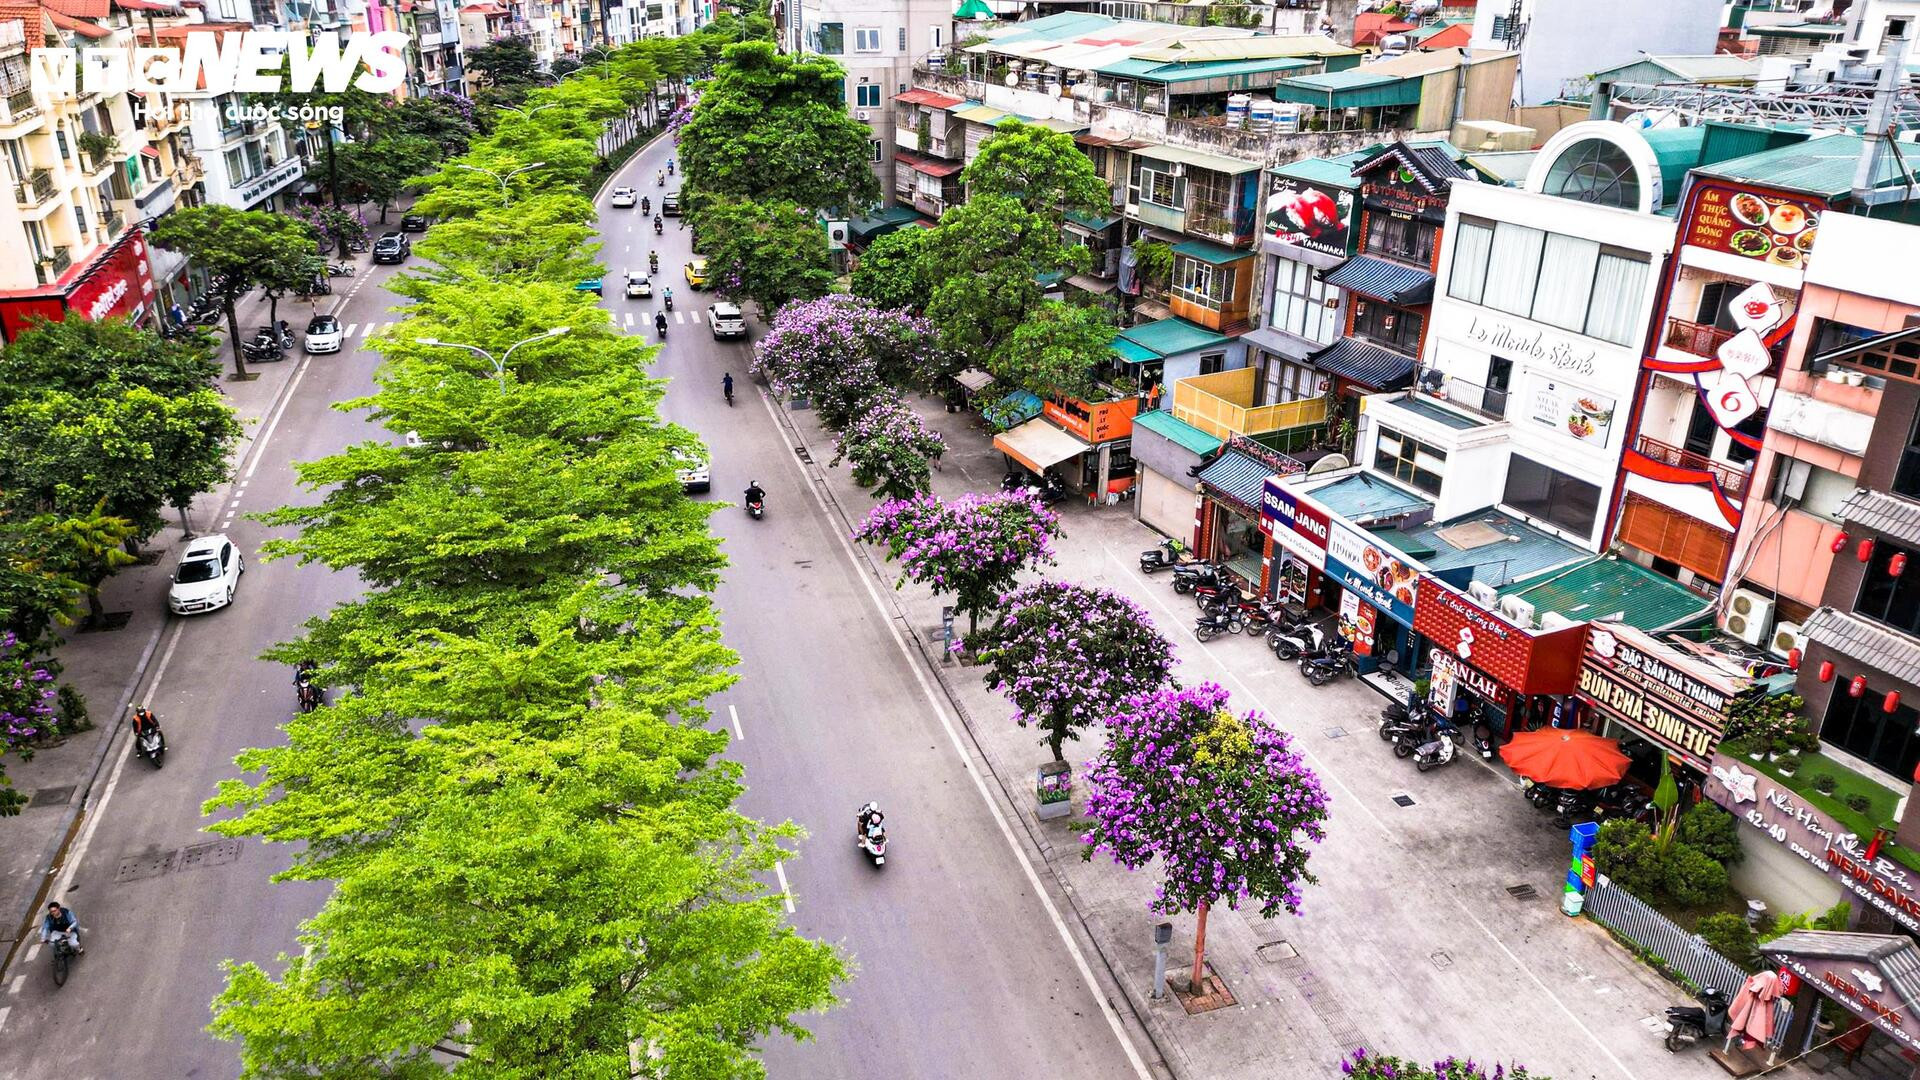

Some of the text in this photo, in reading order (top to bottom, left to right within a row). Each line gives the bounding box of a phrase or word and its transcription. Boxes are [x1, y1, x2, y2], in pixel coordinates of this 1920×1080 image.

[1302, 239, 1345, 257] YAMANAKA
[1264, 491, 1295, 520] SSAM
[1295, 512, 1328, 540] JANG
[1620, 647, 1643, 671] ĐẶC
[1643, 658, 1668, 682] SẢN
[1667, 670, 1686, 691] HÀ
[1685, 678, 1725, 712] THÀNH
[1580, 668, 1714, 757] BÚN CHẢ SINH TỪ
[1766, 788, 1796, 817] Nhà
[1796, 807, 1834, 852] Hàng
[1874, 855, 1915, 893] Bản
[1826, 848, 1874, 886] NEW
[1872, 876, 1920, 921] SAKE
[1855, 883, 1874, 902] 024
[1897, 911, 1920, 932] 1092
[1824, 970, 1861, 998] NEW
[1860, 993, 1904, 1026] SAKE
[1879, 1017, 1894, 1032] Tel:
[1894, 1028, 1911, 1043] 024
